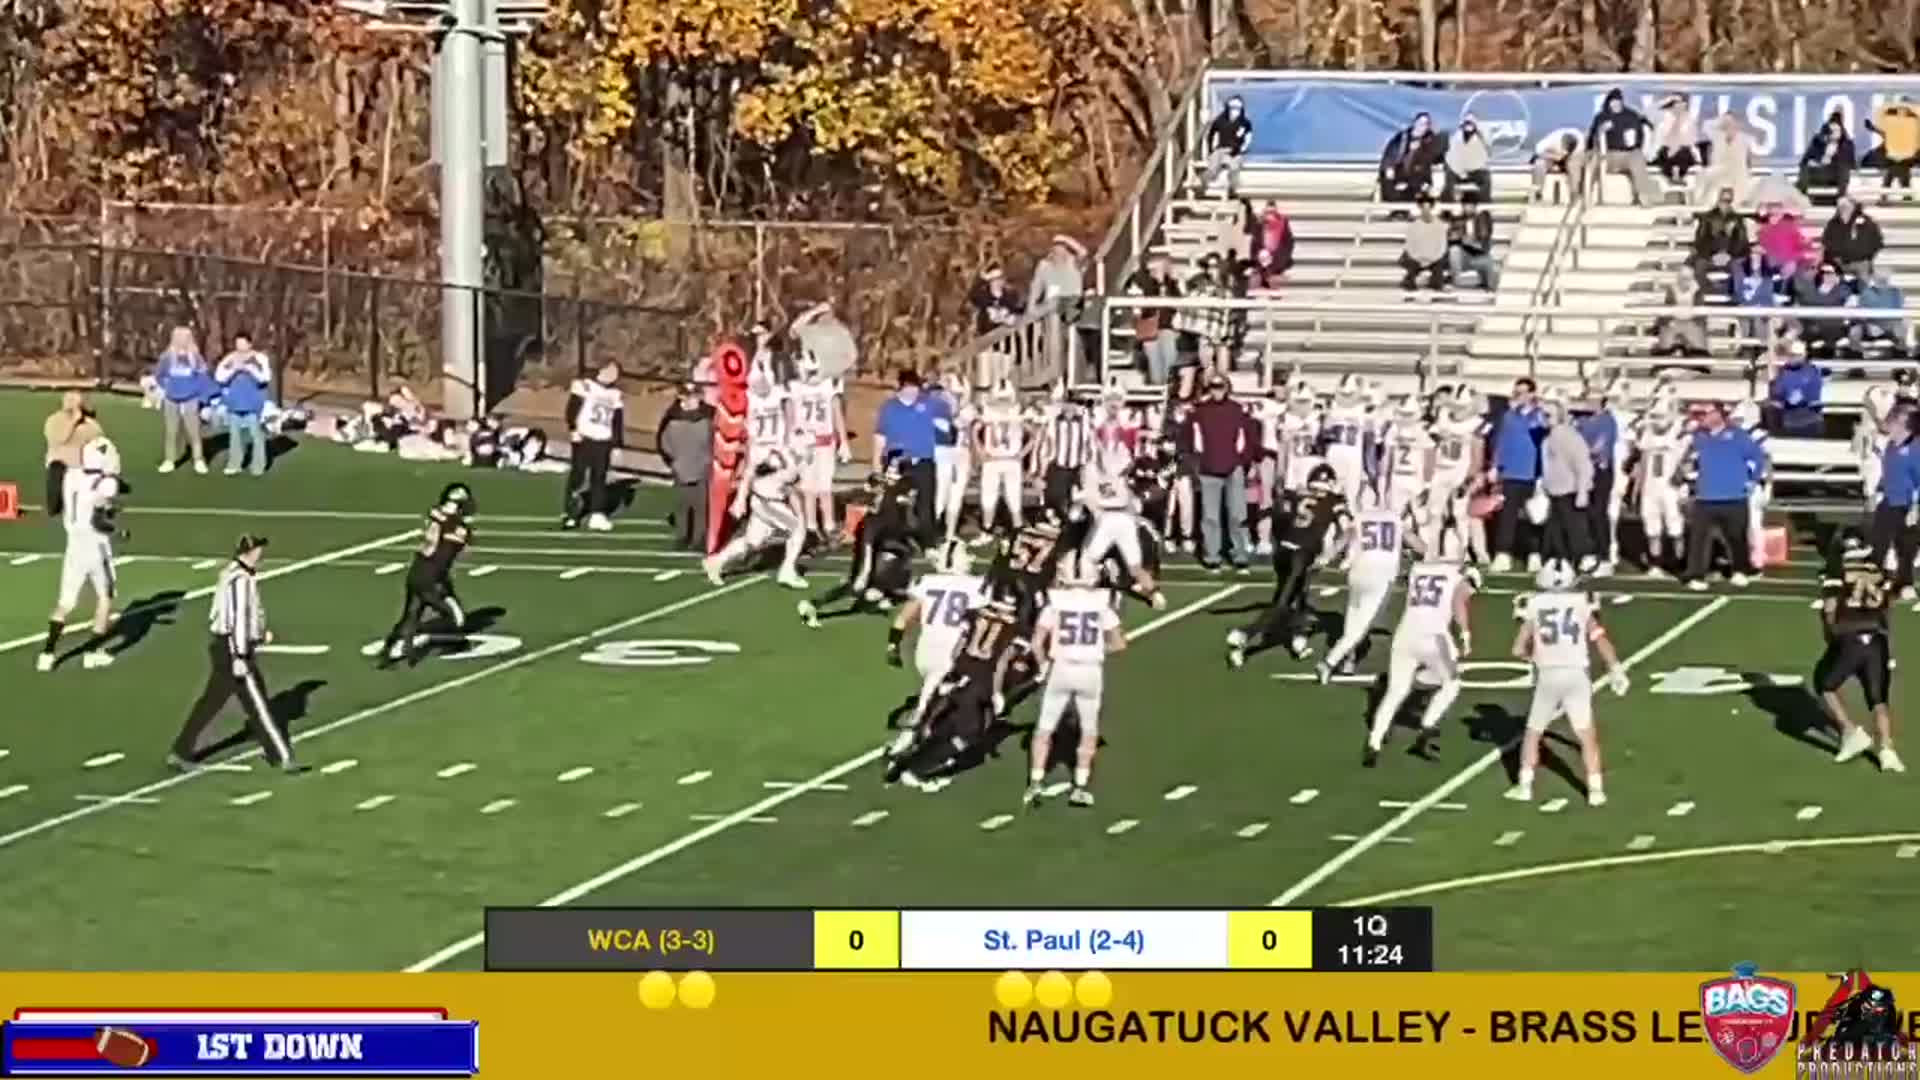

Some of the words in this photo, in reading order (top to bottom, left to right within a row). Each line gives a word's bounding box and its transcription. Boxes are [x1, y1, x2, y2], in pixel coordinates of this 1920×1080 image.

[1296, 498, 1317, 528] 5
[1361, 520, 1396, 551] 50
[925, 589, 970, 626] 78
[1410, 574, 1448, 607] 55
[1058, 610, 1100, 646] 56
[1537, 607, 1580, 645] 54
